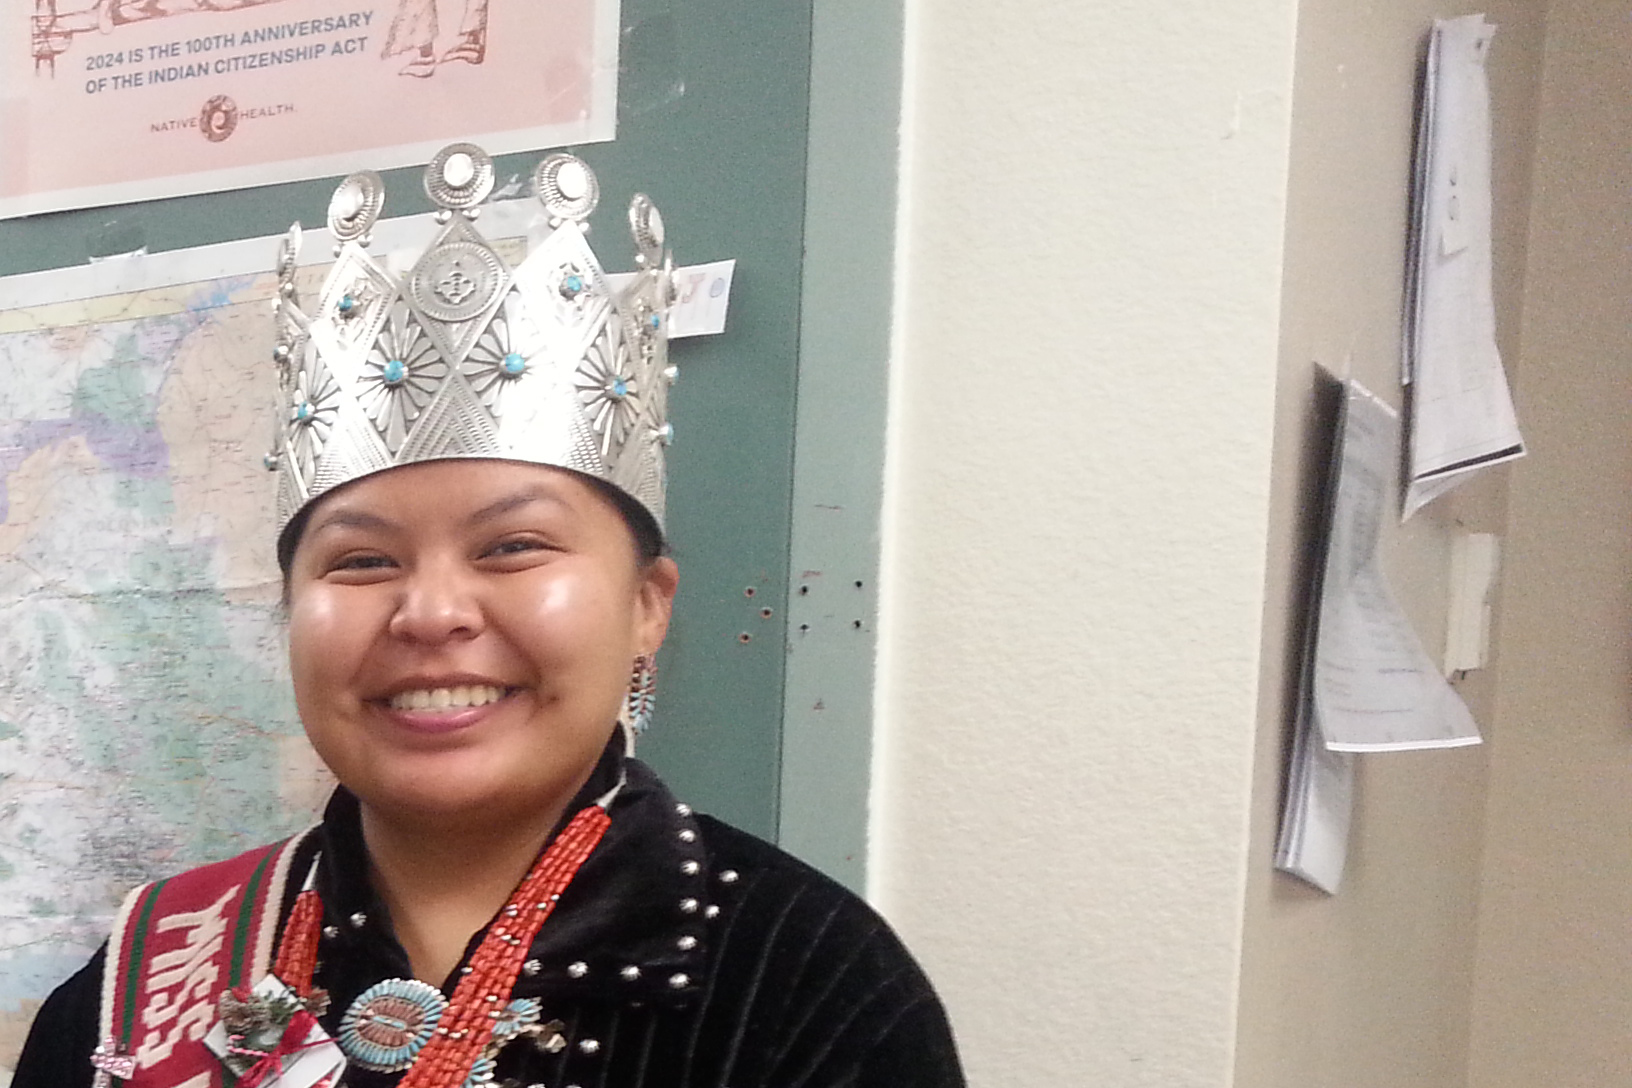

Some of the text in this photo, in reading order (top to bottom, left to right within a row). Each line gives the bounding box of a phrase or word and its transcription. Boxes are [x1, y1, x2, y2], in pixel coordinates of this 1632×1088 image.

[85, 36, 369, 94] OF THE INDIAN CITIZENSHIP ACT
[86, 11, 374, 71] 2024 IS THE 100TH ANNIVERSARY
[150, 117, 198, 133] NATIVE
[136, 883, 242, 1069] MISS
